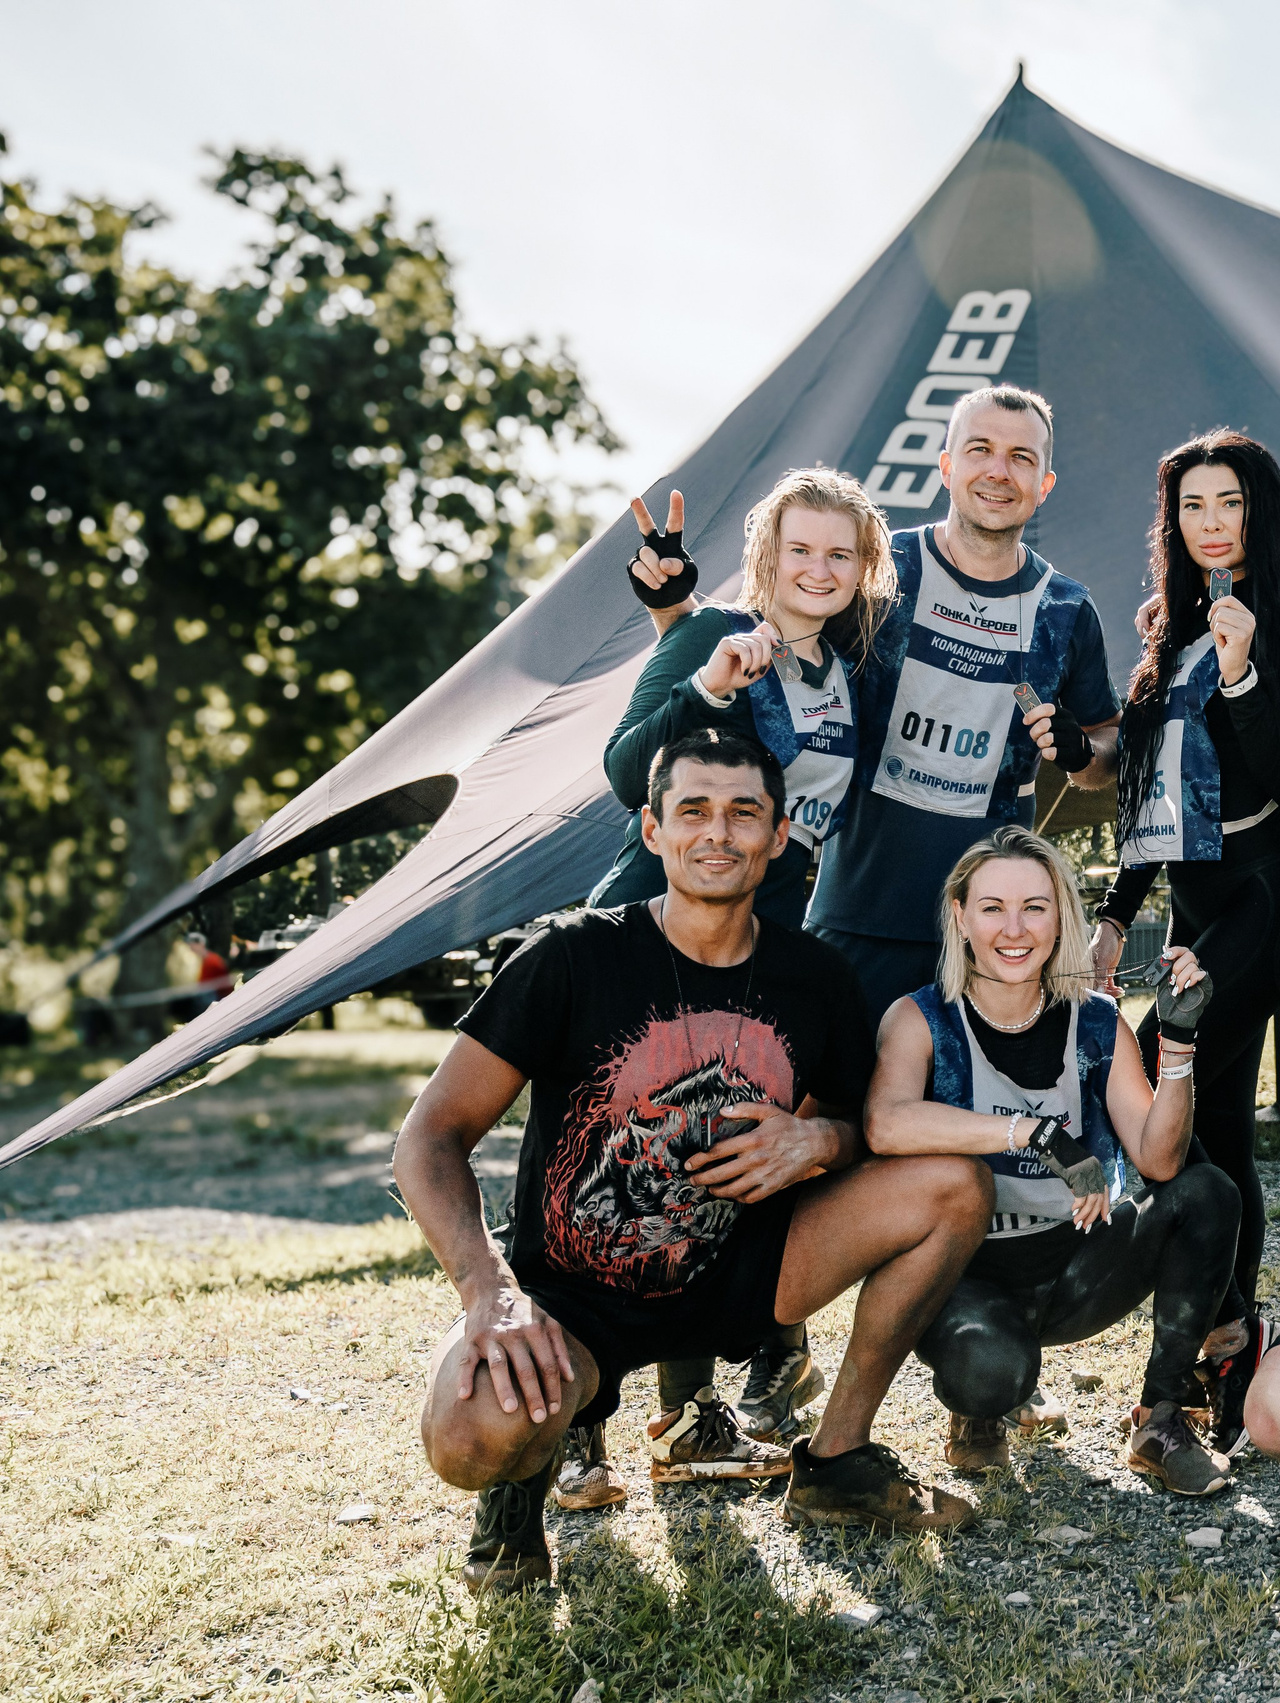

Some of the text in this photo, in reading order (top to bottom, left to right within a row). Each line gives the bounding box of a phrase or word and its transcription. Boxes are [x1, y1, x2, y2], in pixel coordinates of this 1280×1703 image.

[863, 289, 1031, 509] ЕРОЕВ
[933, 603, 1018, 633] ГОНКА ГЕРОЕВ
[930, 636, 1007, 666] КОМАНДНЫЙ
[948, 658, 983, 677] СТАРТ
[900, 711, 991, 759] 01108
[908, 768, 988, 795] ГАЗПРОМБАНК
